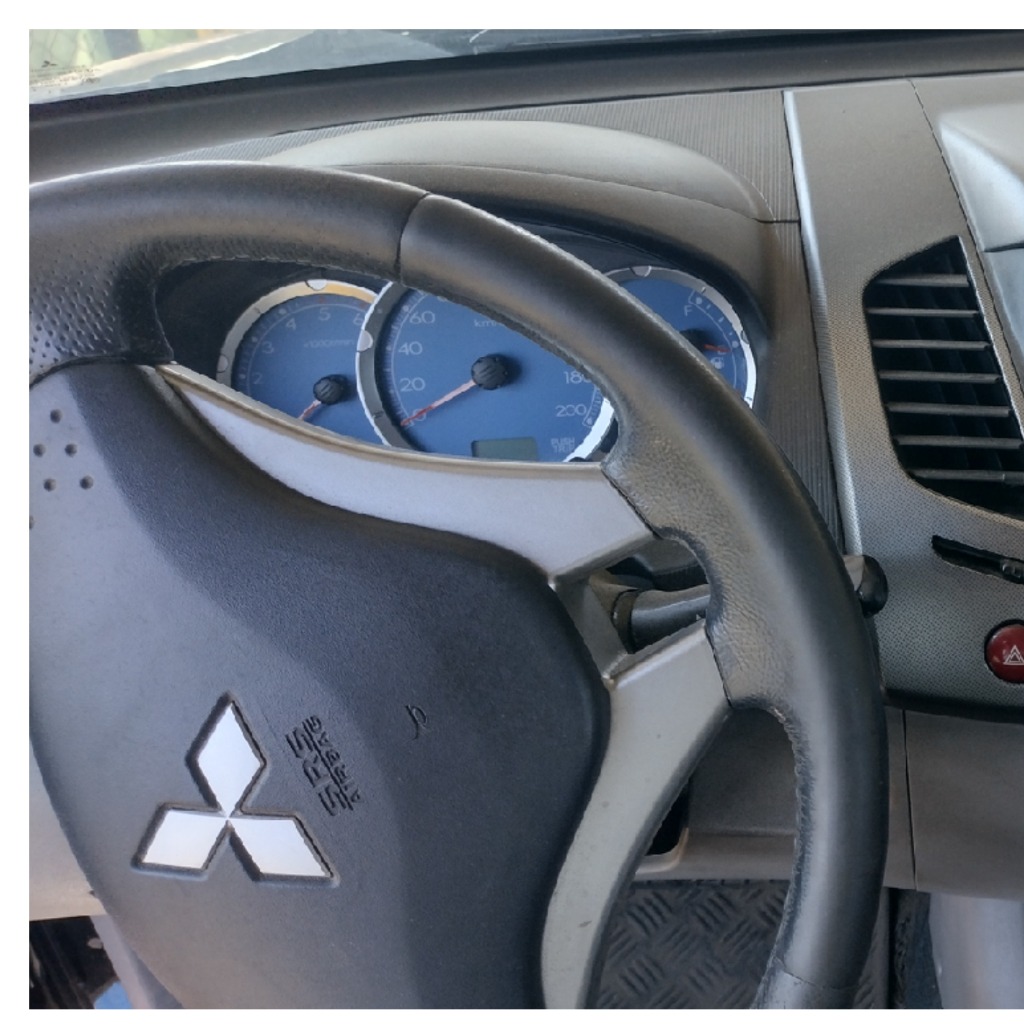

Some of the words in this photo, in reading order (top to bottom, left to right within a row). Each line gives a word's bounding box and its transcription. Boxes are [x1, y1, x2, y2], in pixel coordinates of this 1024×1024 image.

[319, 307, 331, 321] 5
[409, 310, 436, 324] 60
[285, 317, 297, 331] 4
[262, 341, 275, 354] 3
[398, 341, 423, 355] 40
[400, 377, 426, 392] 20
[555, 403, 587, 418] 200
